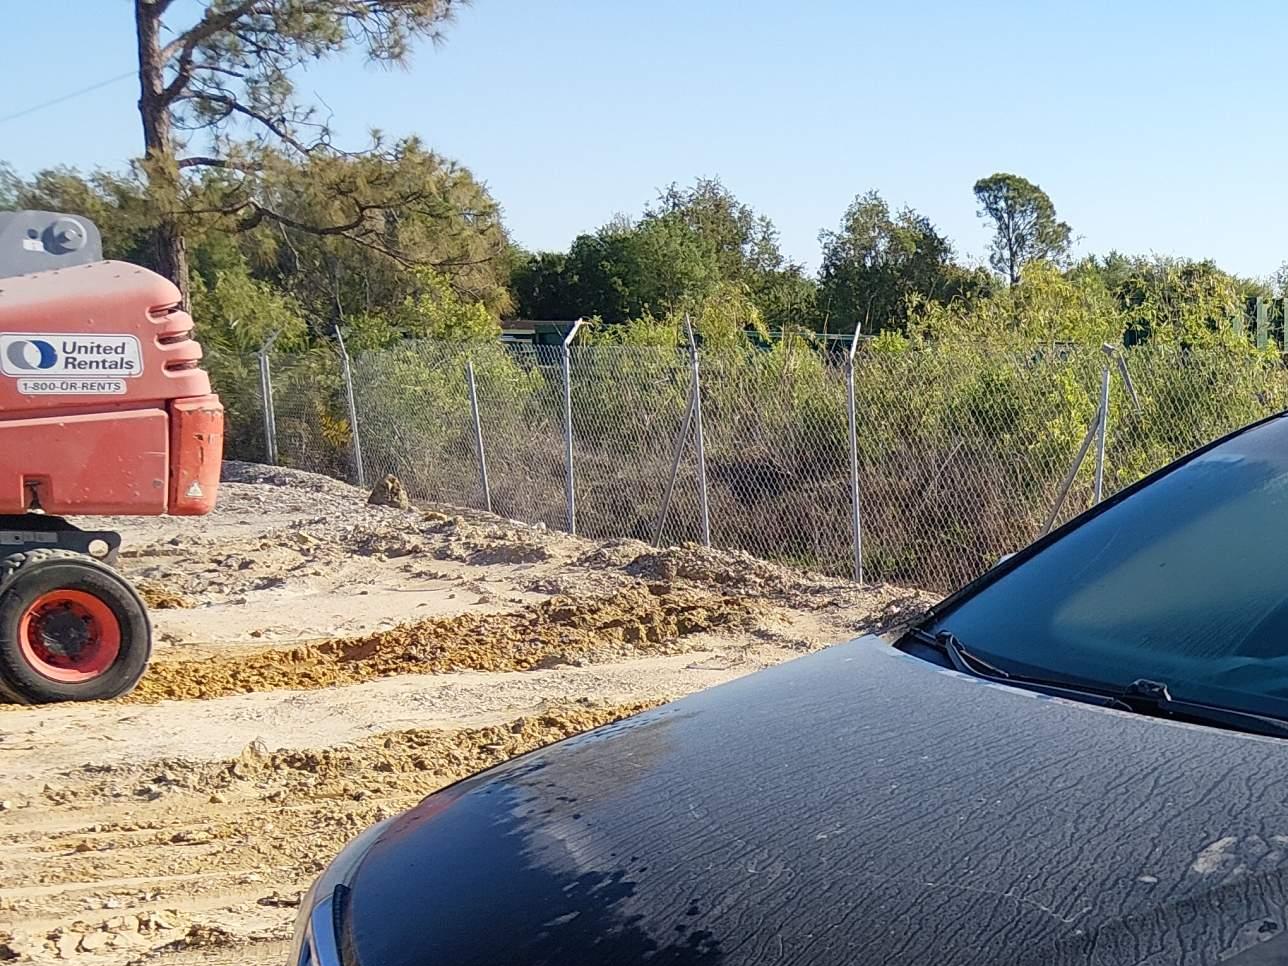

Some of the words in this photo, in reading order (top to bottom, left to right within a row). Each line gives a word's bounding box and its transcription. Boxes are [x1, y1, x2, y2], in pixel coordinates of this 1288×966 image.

[62, 340, 126, 355] United
[63, 355, 135, 371] Rentals
[22, 381, 122, 392] 1-800-OR-RENTS
